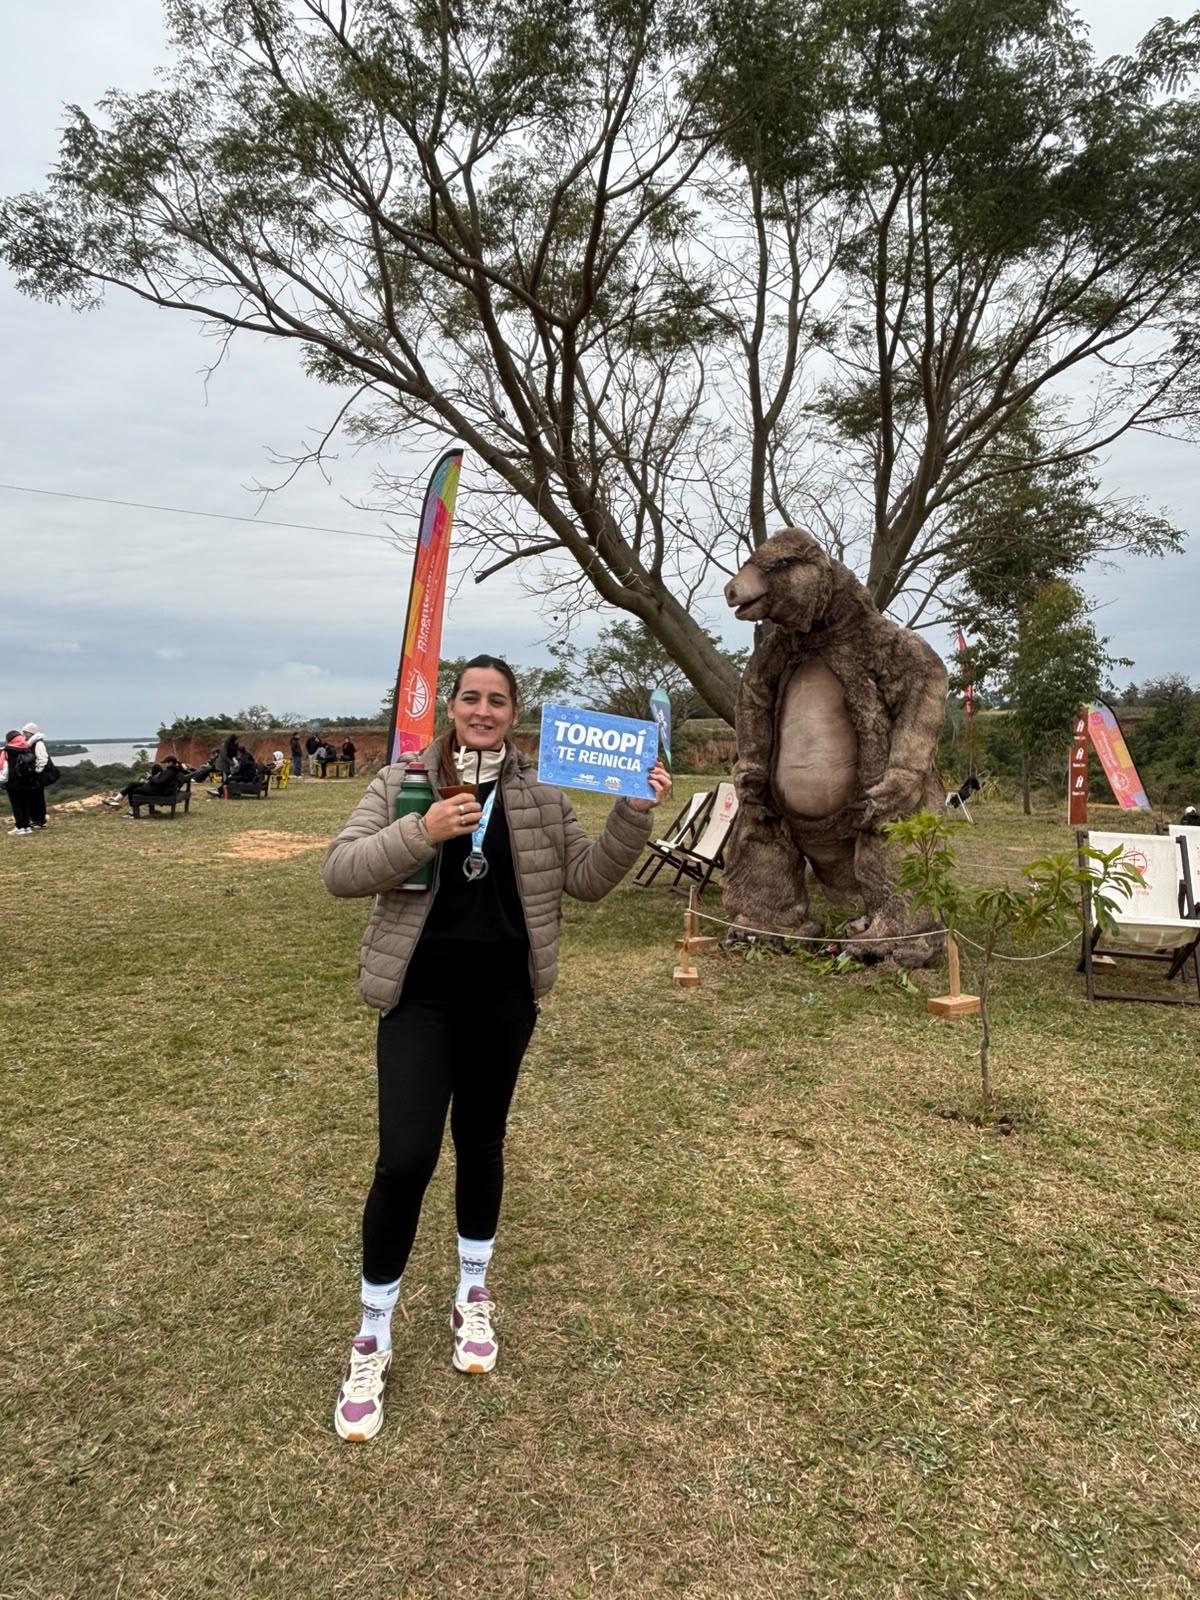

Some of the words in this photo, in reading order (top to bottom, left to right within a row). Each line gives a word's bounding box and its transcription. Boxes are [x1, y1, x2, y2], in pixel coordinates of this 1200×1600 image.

[554, 720, 646, 755] TOROPÍ
[557, 746, 577, 761] TE
[578, 749, 641, 772] REINICIA
